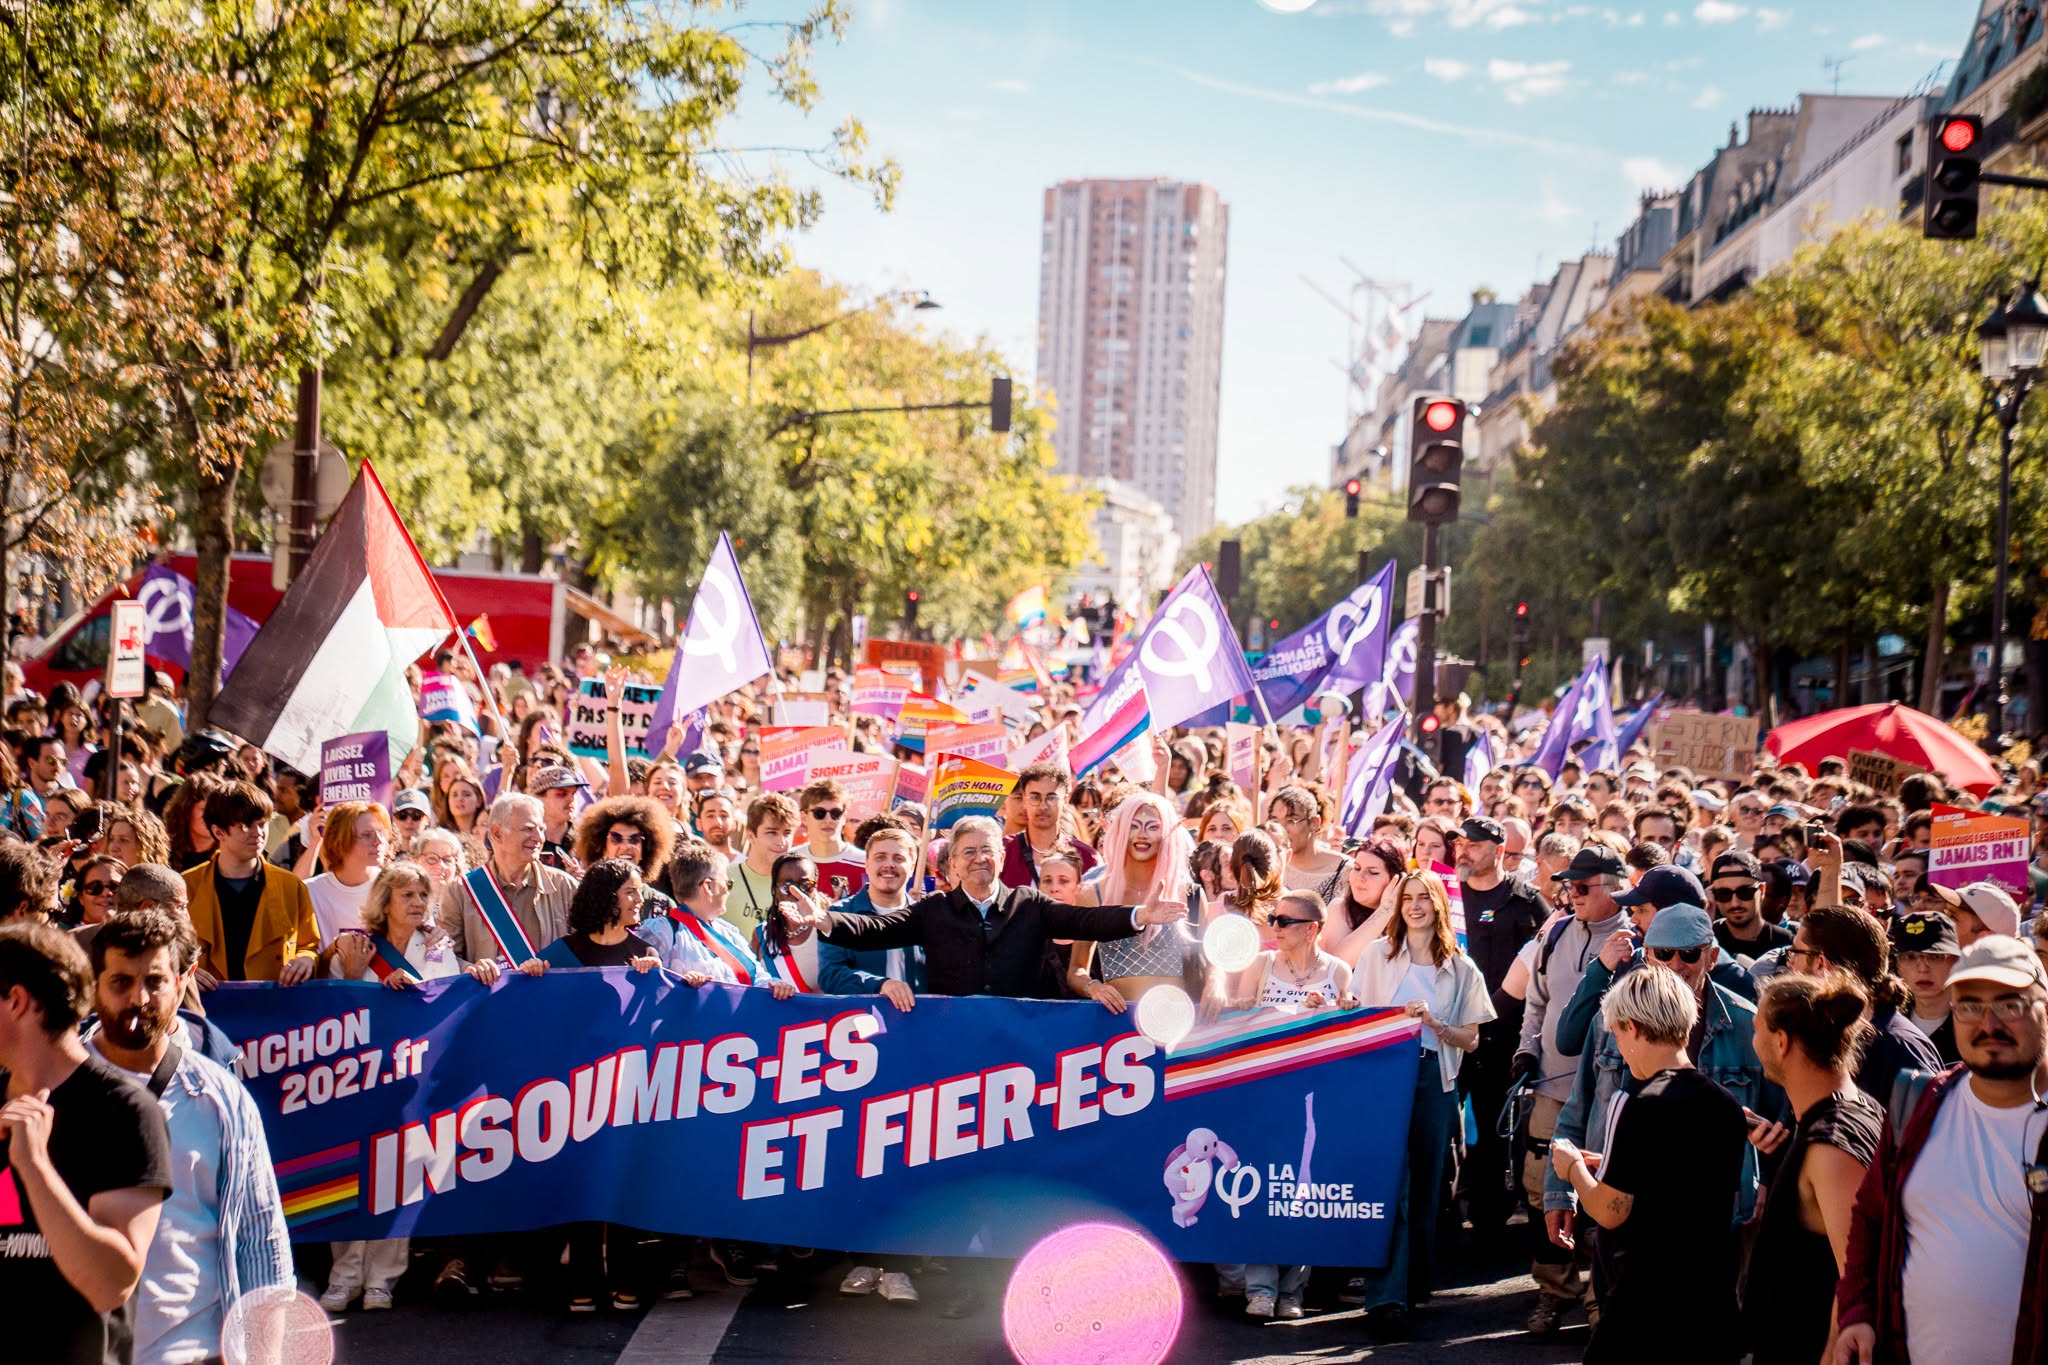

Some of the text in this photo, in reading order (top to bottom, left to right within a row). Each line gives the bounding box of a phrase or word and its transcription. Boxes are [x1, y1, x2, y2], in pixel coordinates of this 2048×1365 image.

[576, 705, 605, 723] PAS
[324, 743, 364, 764] LAISSEZ
[765, 752, 809, 776] JAMAI
[323, 762, 376, 785] VIVRE LES
[811, 761, 880, 779] SIGNEZ SUR
[322, 782, 372, 803] ENFANTS
[971, 781, 1005, 792] HOMO,
[959, 793, 994, 804] FACHO
[1936, 834, 1973, 848] TOUJOURS
[1935, 844, 1988, 867] JAMAIS
[2017, 840, 2024, 857] !
[233, 1007, 371, 1081] NCHON
[280, 1037, 429, 1115] 2027.fr
[368, 1009, 880, 1216] INSOUMIS-ES
[737, 1031, 1157, 1200] ET FIER-ES
[1268, 1163, 1295, 1181] LA
[1268, 1181, 1354, 1201] FRANCE
